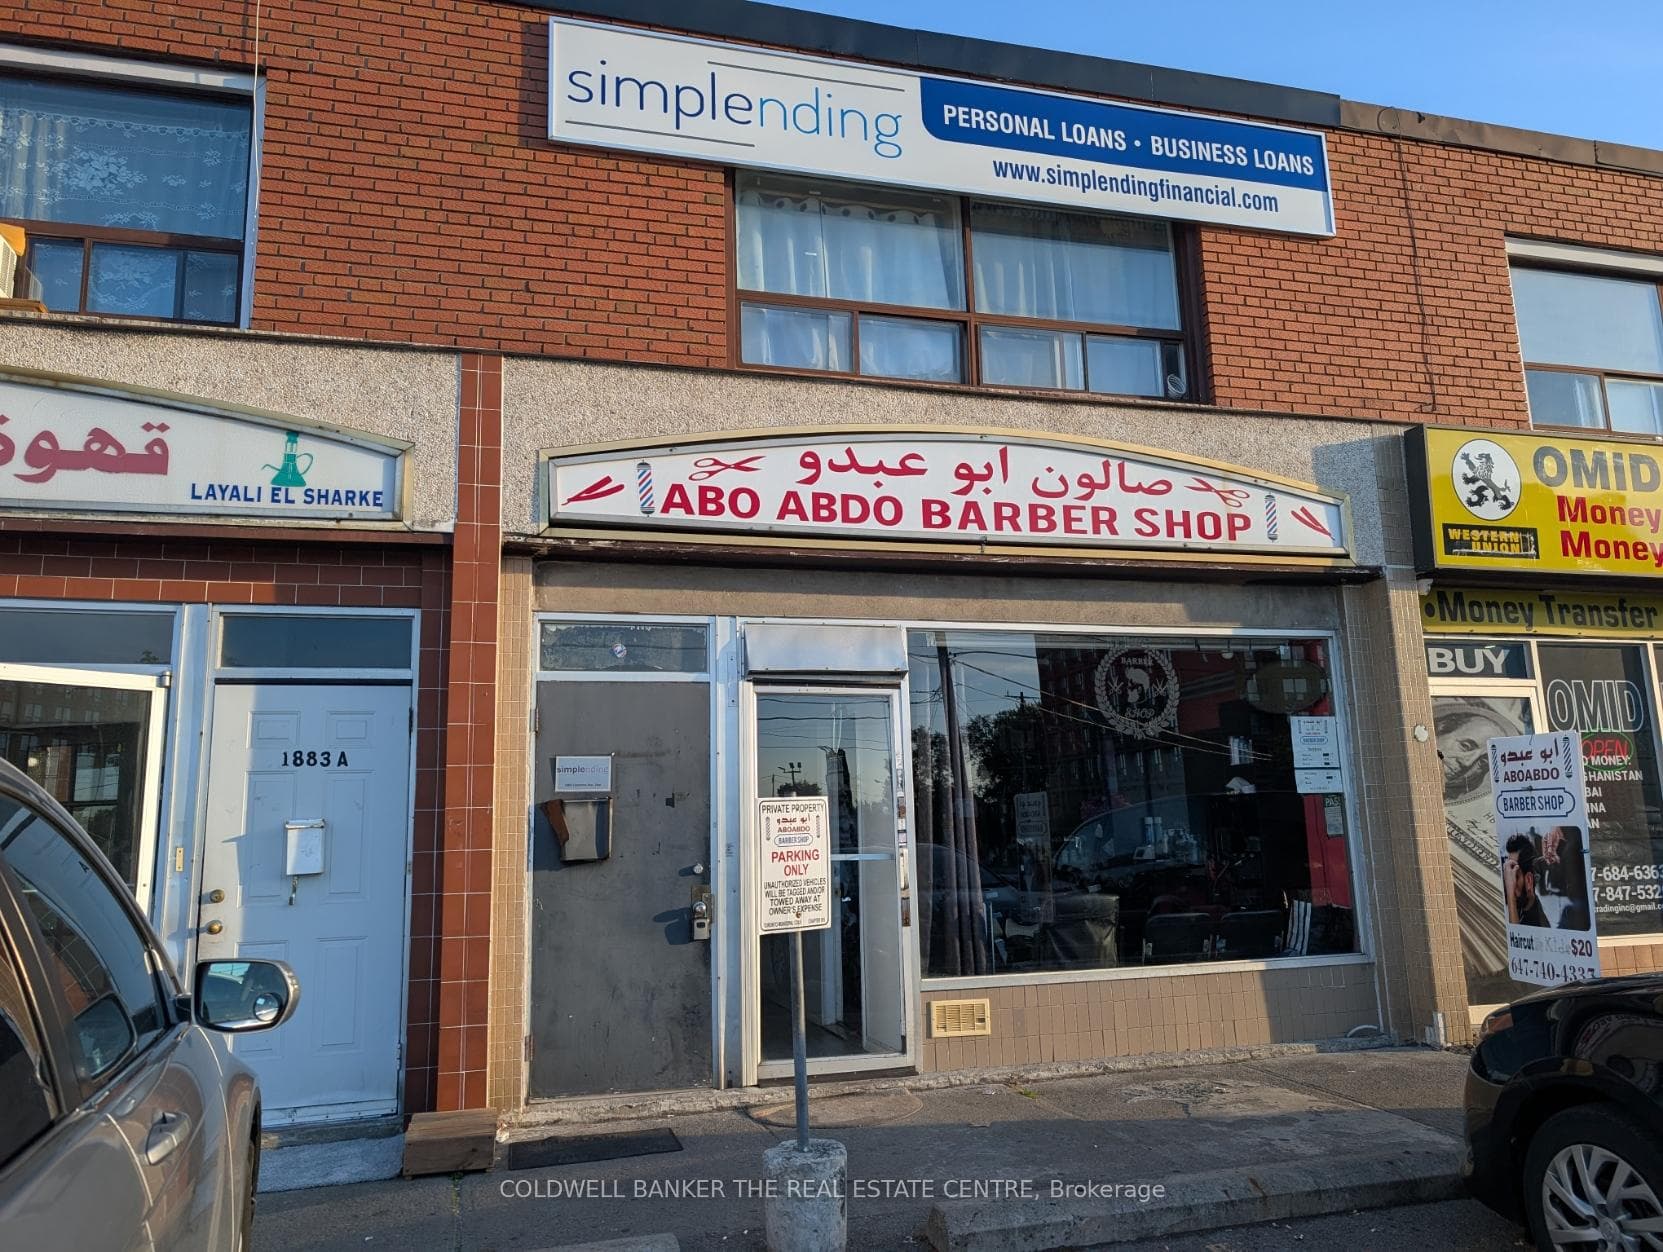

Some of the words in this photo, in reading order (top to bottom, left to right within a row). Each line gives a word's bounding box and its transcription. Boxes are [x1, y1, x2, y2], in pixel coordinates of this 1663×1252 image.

[567, 59, 902, 159] simplending
[943, 104, 1055, 141] PERSONAL
[1061, 122, 1127, 152] LOANS
[1150, 135, 1248, 167] BUSINESS
[1253, 148, 1314, 176] LOANS
[992, 160, 1279, 213] www.simplendingfinancial.com
[795, 446, 929, 489] عبدو
[950, 446, 1009, 496] ابو
[1532, 445, 1661, 493] OMID
[1031, 459, 1173, 501] صالون
[191, 483, 262, 503] LAYALI
[271, 487, 296, 505] EL
[303, 488, 384, 507] SHARKE
[660, 483, 761, 518] ABO
[776, 490, 904, 527] ABDO
[922, 499, 1120, 537] BARBER
[1133, 507, 1252, 541] SHOP
[1556, 495, 1662, 534] Money
[1448, 528, 1521, 542] WESTERN
[1472, 541, 1521, 554] UNION
[1560, 529, 1663, 569] Money
[1538, 593, 1658, 629] Transfer
[1426, 647, 1510, 674] BUY
[1546, 678, 1645, 733] OMID
[281, 750, 331, 767] 1883
[337, 751, 349, 767] A
[1500, 748, 1533, 767] عبدو
[1540, 737, 1559, 764] ابو
[1581, 739, 1630, 760] OPEN
[1591, 755, 1632, 766] MONEY:
[1503, 767, 1560, 783] ABOABDO
[762, 804, 790, 814] PRIVATE
[791, 803, 824, 813] PROPERTY
[1502, 796, 1537, 812] BARBER
[1538, 795, 1564, 811] SHOP
[772, 849, 820, 863] PARKING
[784, 864, 809, 876] ONLY
[764, 879, 802, 889] UNAUTHORIZED
[803, 878, 826, 886] VEHICLES
[765, 890, 778, 898] WILL
[778, 889, 786, 897] BE
[787, 888, 806, 896] TAGGED
[769, 897, 794, 906] TOWED
[795, 896, 812, 905] AWAY
[769, 906, 796, 916] OWNER'S
[797, 904, 823, 913] EXPENSE
[1509, 931, 1535, 951] Haircut
[1571, 938, 1593, 957] $20
